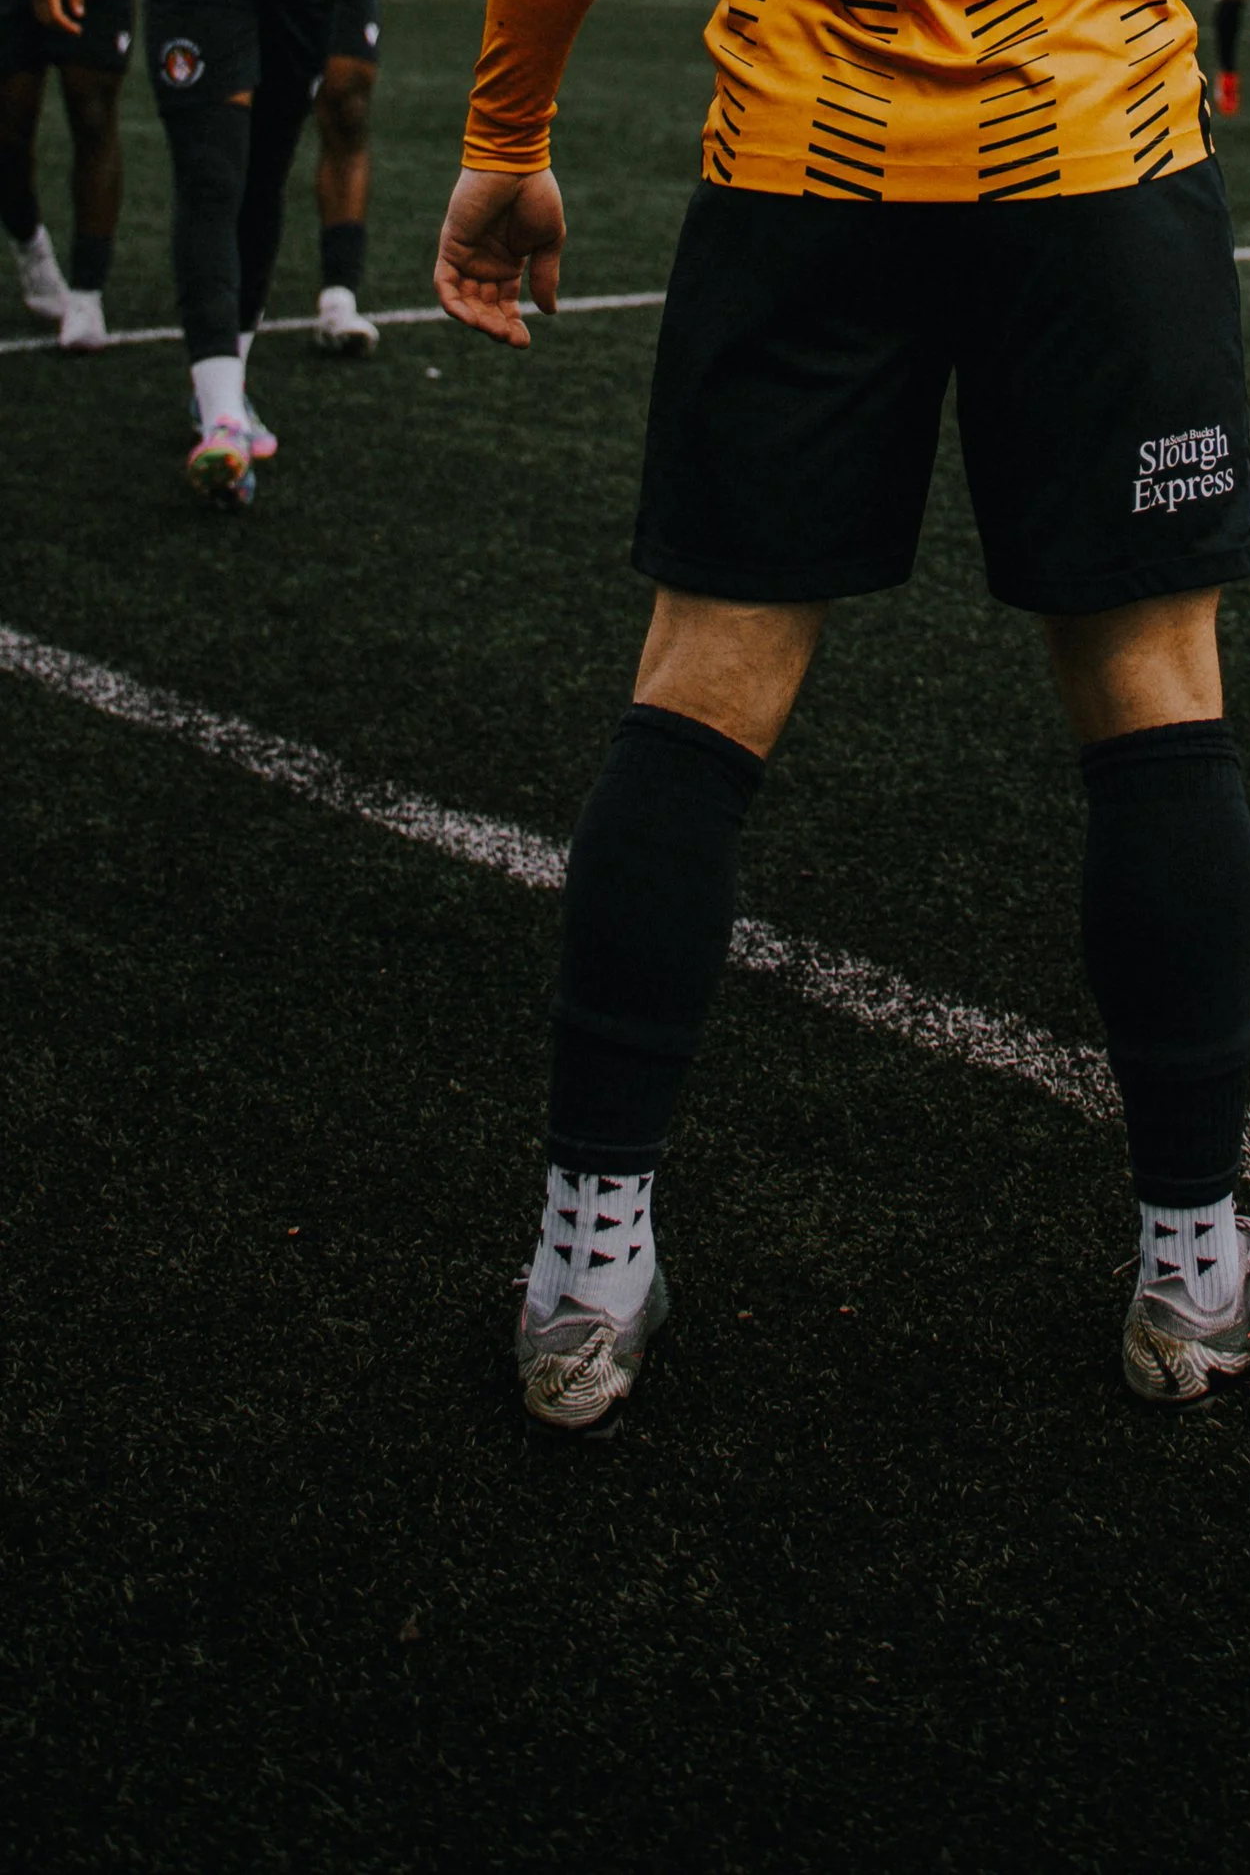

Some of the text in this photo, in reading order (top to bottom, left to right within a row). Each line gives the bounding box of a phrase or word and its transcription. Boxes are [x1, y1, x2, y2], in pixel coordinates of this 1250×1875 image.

[1138, 424, 1230, 476] Slough
[1189, 426, 1215, 440] Bucks
[1131, 467, 1235, 513] Express
